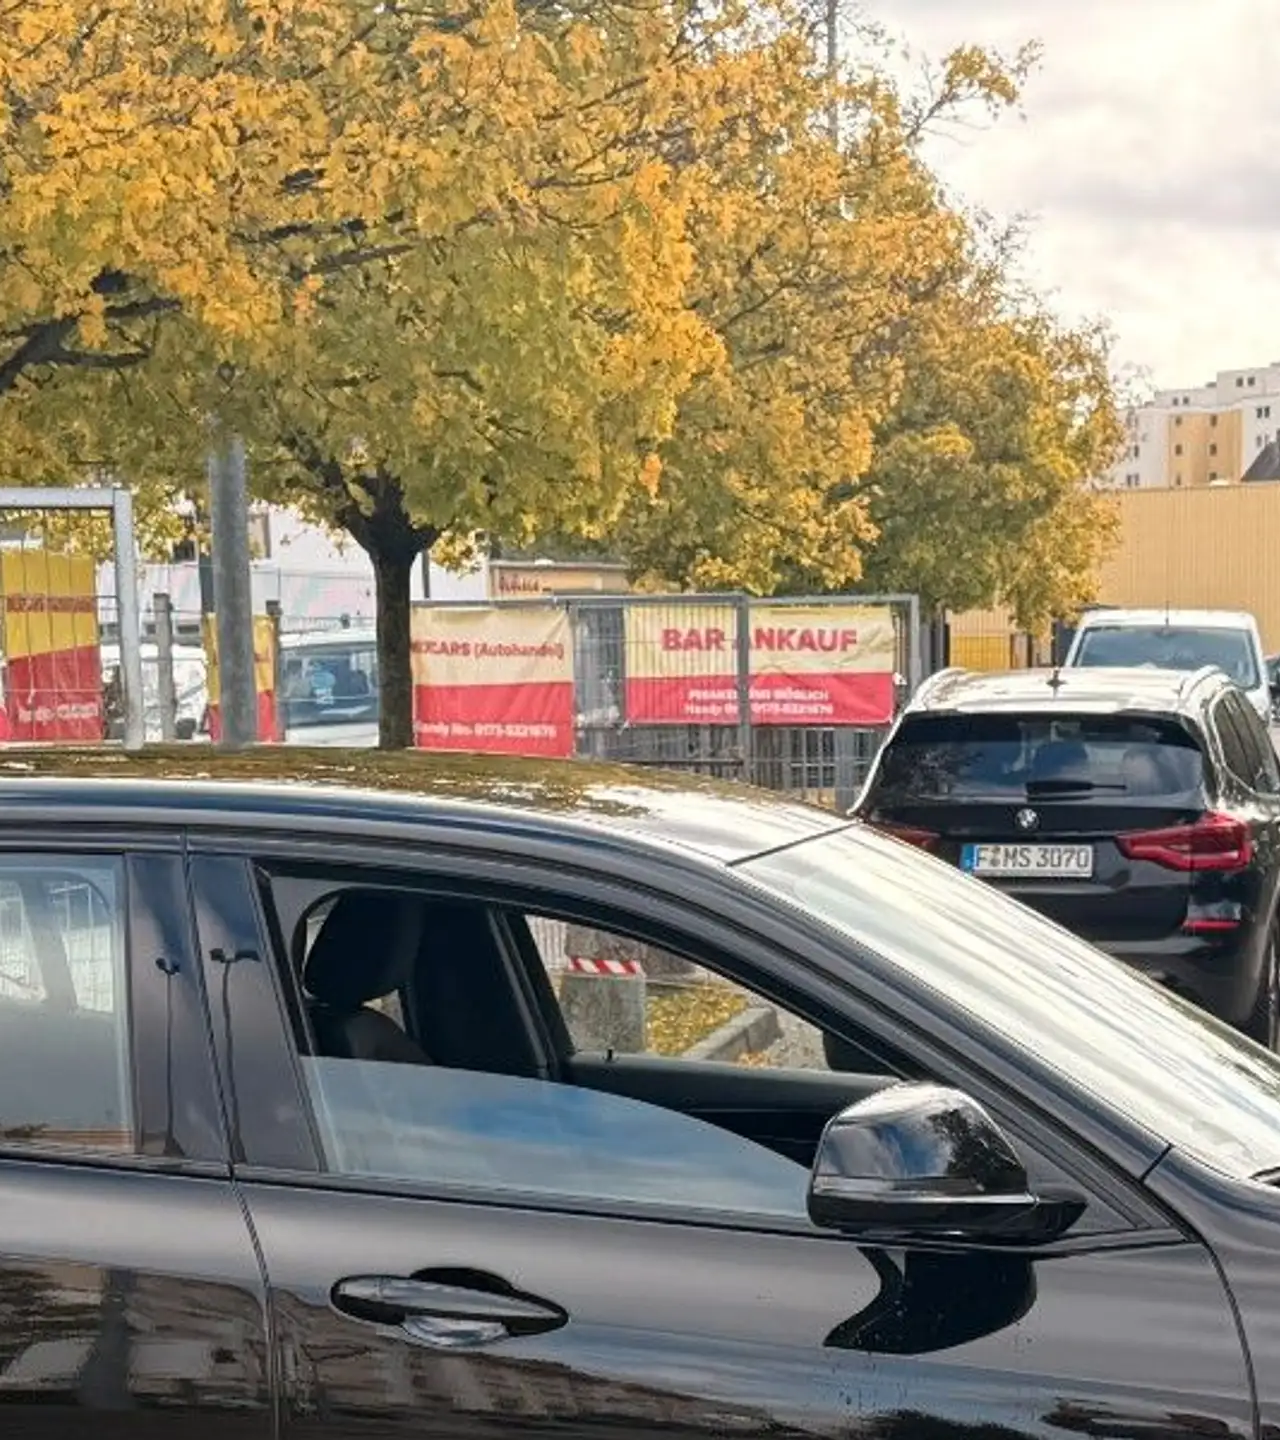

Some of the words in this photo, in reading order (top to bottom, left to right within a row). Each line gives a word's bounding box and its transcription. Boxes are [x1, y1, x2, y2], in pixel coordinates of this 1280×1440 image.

[661, 628, 726, 652] BAR
[1003, 847, 1031, 868] MS
[1036, 847, 1089, 868] 3070
